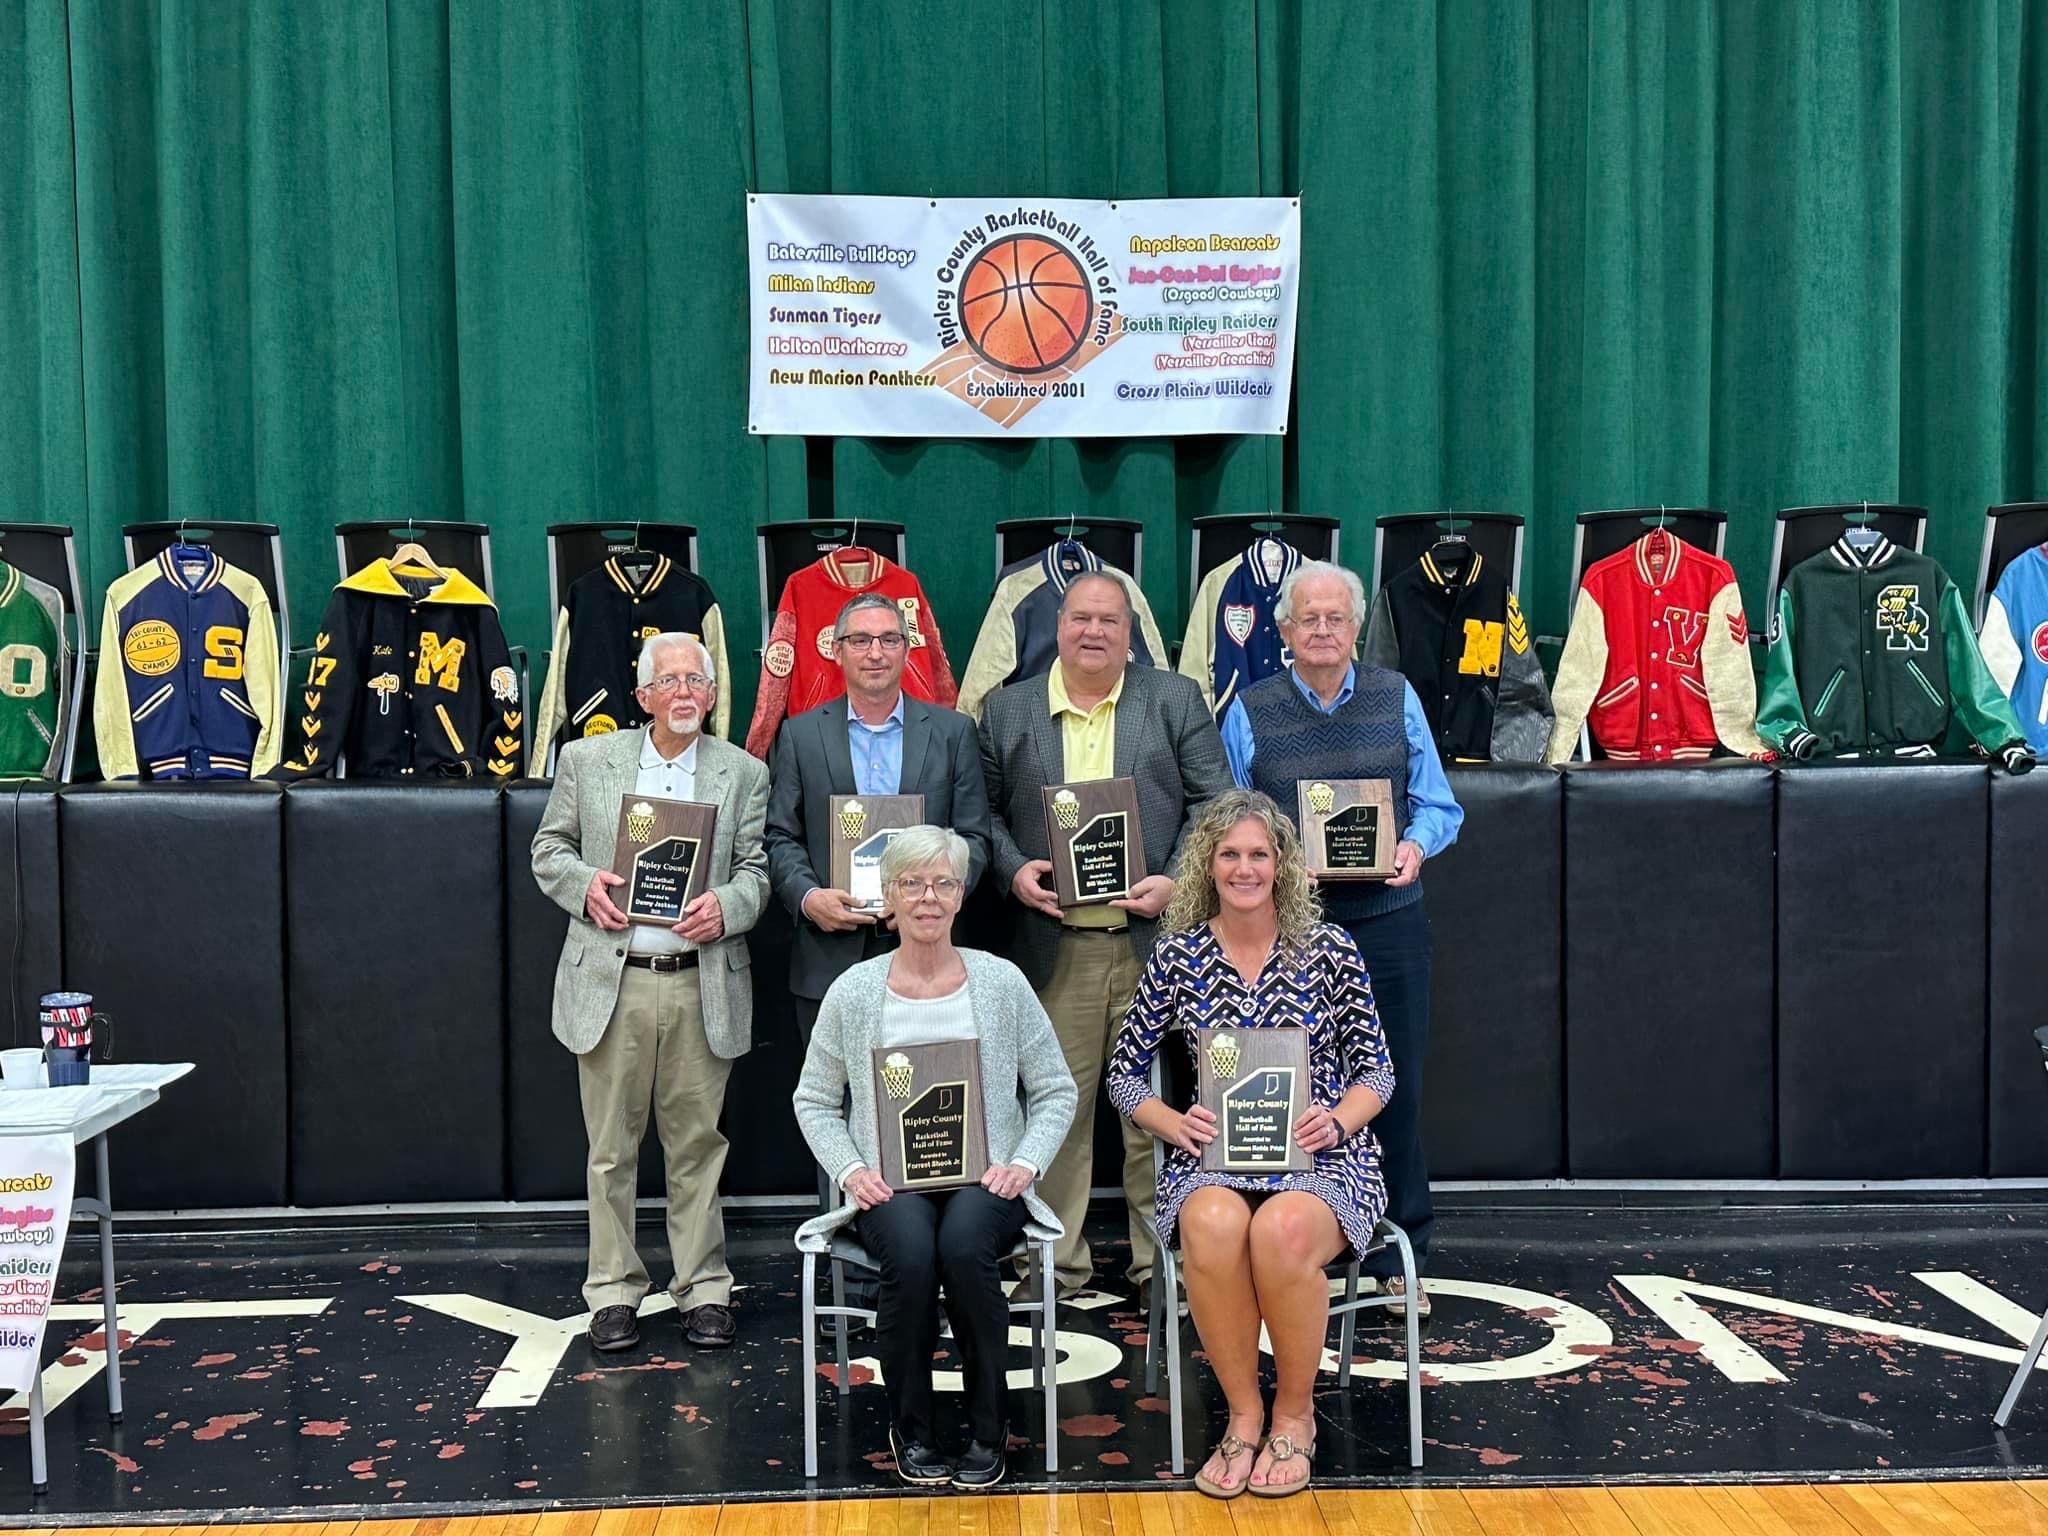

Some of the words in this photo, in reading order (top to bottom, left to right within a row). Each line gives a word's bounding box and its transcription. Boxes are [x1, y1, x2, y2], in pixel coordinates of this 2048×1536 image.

[985, 207, 1081, 242] Basketball
[937, 225, 987, 283] County
[1077, 235, 1108, 273] Hall
[1130, 234, 1206, 257] Napoleon
[1210, 234, 1280, 251] Bearcats
[768, 243, 845, 263] Batesville
[847, 245, 916, 269] Bulldogs
[768, 274, 813, 292] Milan
[817, 275, 875, 294] Indians
[1097, 276, 1116, 294] of
[1230, 264, 1281, 286] Eagles
[1163, 287, 1216, 305] (Osgood
[1218, 284, 1280, 302] Cowboys)
[769, 307, 828, 323] Sunman
[833, 307, 881, 327] Tigers
[933, 288, 959, 349] Ripley
[1094, 300, 1118, 346] Fame
[1121, 317, 1163, 332] South
[1168, 316, 1217, 335] Ripley
[1222, 314, 1278, 329] Raiders
[768, 336, 822, 355] Holton
[824, 337, 907, 356] Warhorses
[1183, 335, 1246, 351] (Versailles
[1246, 333, 1276, 348] Lions)
[1156, 353, 1218, 370] (Versailles
[1219, 351, 1274, 367] Frenchies)
[770, 369, 804, 384] New
[809, 368, 864, 385] Marion
[869, 369, 936, 385] Panthers
[966, 382, 1047, 398] Established
[1052, 382, 1085, 397] 2001
[1117, 383, 1160, 398] Cross
[1165, 382, 1210, 397] Plains
[1216, 380, 1272, 396] Wildcats
[1663, 606, 1710, 668] V
[203, 625, 243, 680] S
[415, 631, 466, 693] M
[1074, 843, 1097, 853] Ripley
[1098, 840, 1123, 848] County
[638, 860, 661, 871] Ripley
[663, 863, 689, 874] County
[1228, 1099, 1256, 1110] Ripley
[1257, 1099, 1288, 1110] County
[904, 1117, 931, 1127] Ripley
[932, 1114, 962, 1123] County
